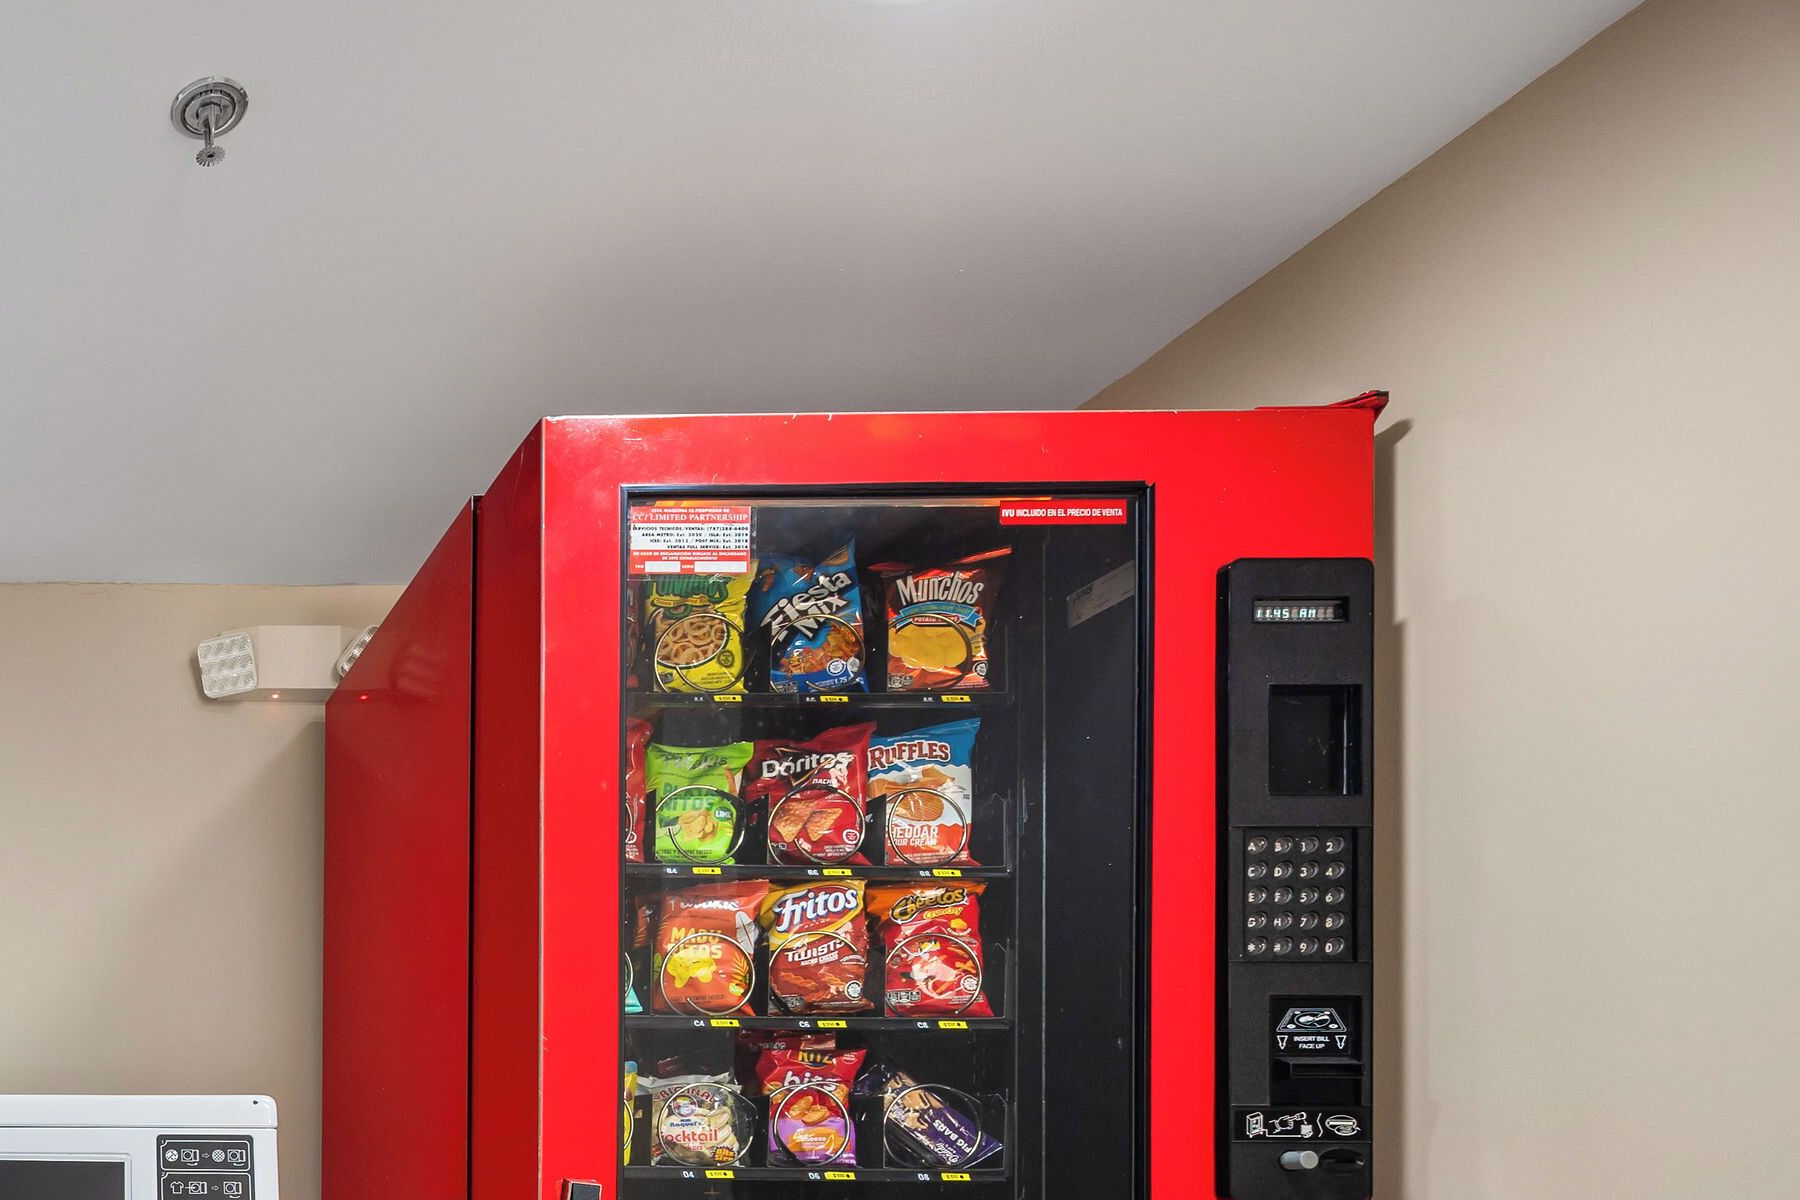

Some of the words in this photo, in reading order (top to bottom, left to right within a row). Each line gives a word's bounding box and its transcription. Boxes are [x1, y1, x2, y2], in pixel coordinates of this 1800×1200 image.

[1002, 509, 1015, 517] IVU
[1016, 509, 1046, 517] INCLUIDO
[1047, 509, 1056, 517] EN
[1058, 509, 1065, 517] EL
[1067, 509, 1091, 517] PRECIO
[1092, 509, 1101, 517] DE
[1102, 509, 1123, 517] VENTA
[896, 571, 984, 605] Munchos
[760, 572, 852, 642] Fiesta
[795, 596, 848, 639] Mix
[1299, 608, 1316, 618] AM
[868, 740, 950, 770] RUFFLES
[762, 752, 855, 778] Doritos
[715, 810, 732, 819] LIME
[910, 838, 937, 846] CREAM
[1247, 842, 1256, 851] A
[1326, 842, 1333, 852] 2
[1274, 843, 1282, 852] B
[1247, 867, 1256, 877] C
[1273, 868, 1282, 877] D
[1299, 867, 1307, 877] 3
[1325, 867, 1333, 876] 4
[1248, 892, 1255, 902] E
[1274, 892, 1281, 902] F
[1299, 893, 1307, 902] 5
[1325, 893, 1333, 902] 6
[772, 889, 858, 932] Fritos
[923, 906, 963, 919] Crunchy
[1247, 918, 1256, 927] G
[1273, 918, 1282, 926] H
[1299, 918, 1307, 927] 7
[1325, 918, 1333, 927] 8
[1299, 943, 1307, 953] 9
[932, 1119, 957, 1141] BARS
[956, 1139, 973, 1154] FIG
